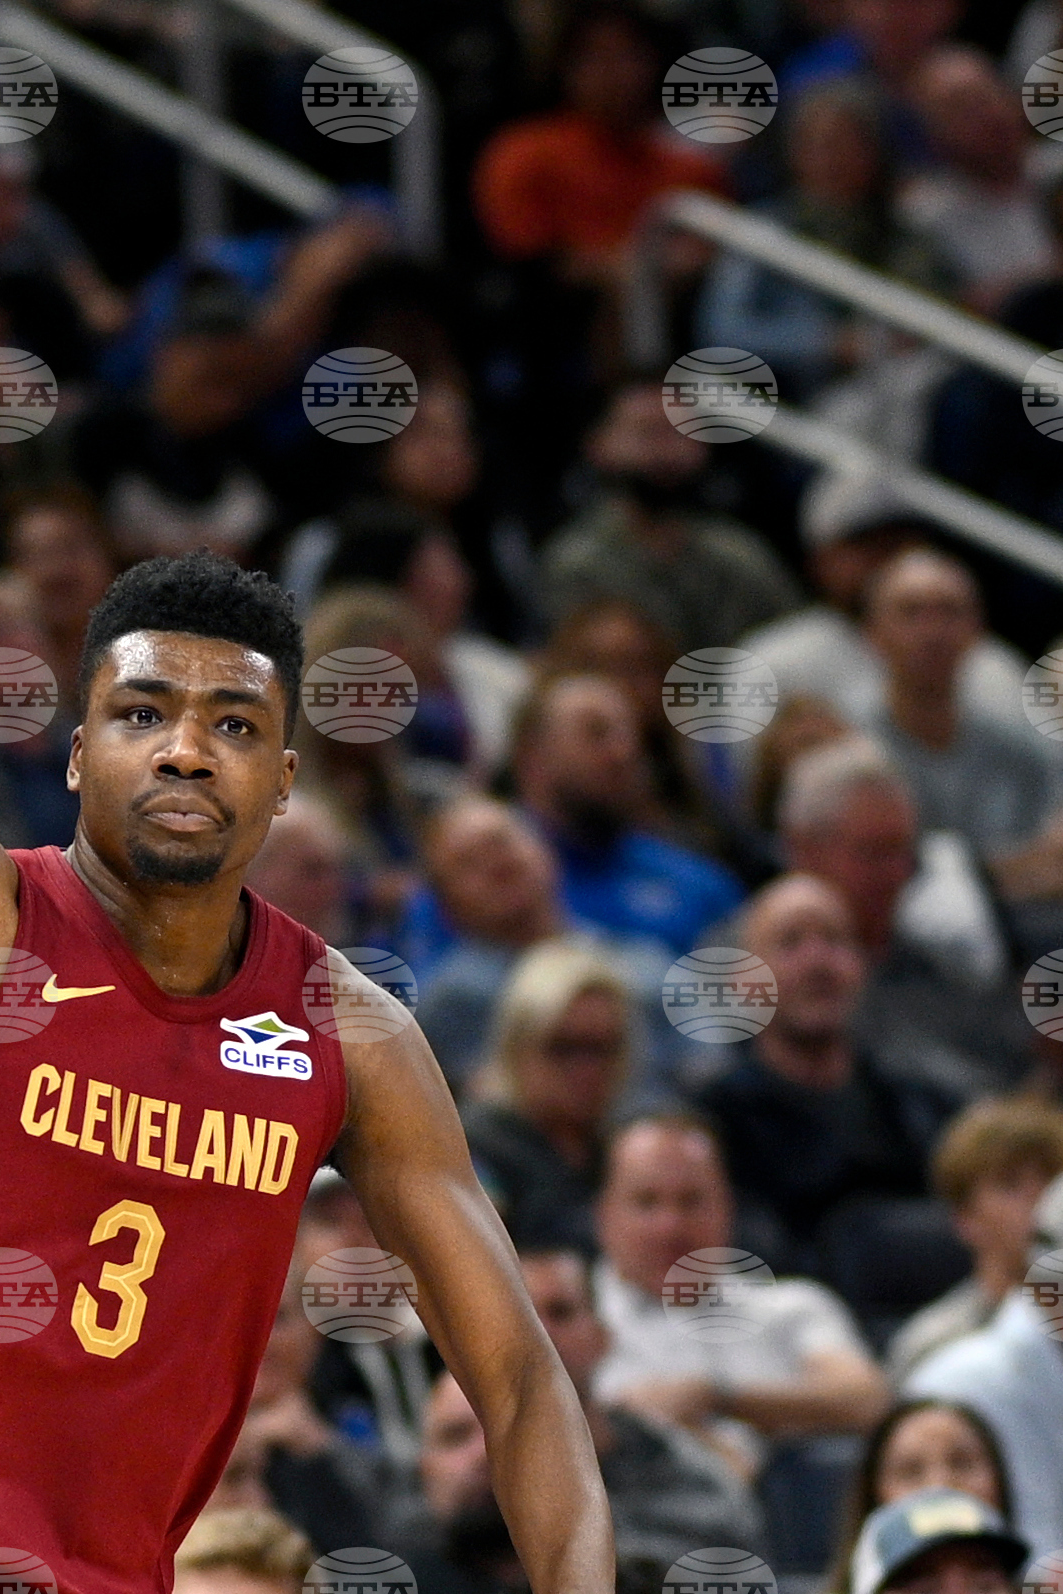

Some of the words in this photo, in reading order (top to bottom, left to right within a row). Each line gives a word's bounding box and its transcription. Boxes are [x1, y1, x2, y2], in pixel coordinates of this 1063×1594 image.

[224, 1047, 308, 1074] CLIFFS
[20, 1063, 299, 1195] CLEVELAND
[71, 1199, 166, 1358] 3
